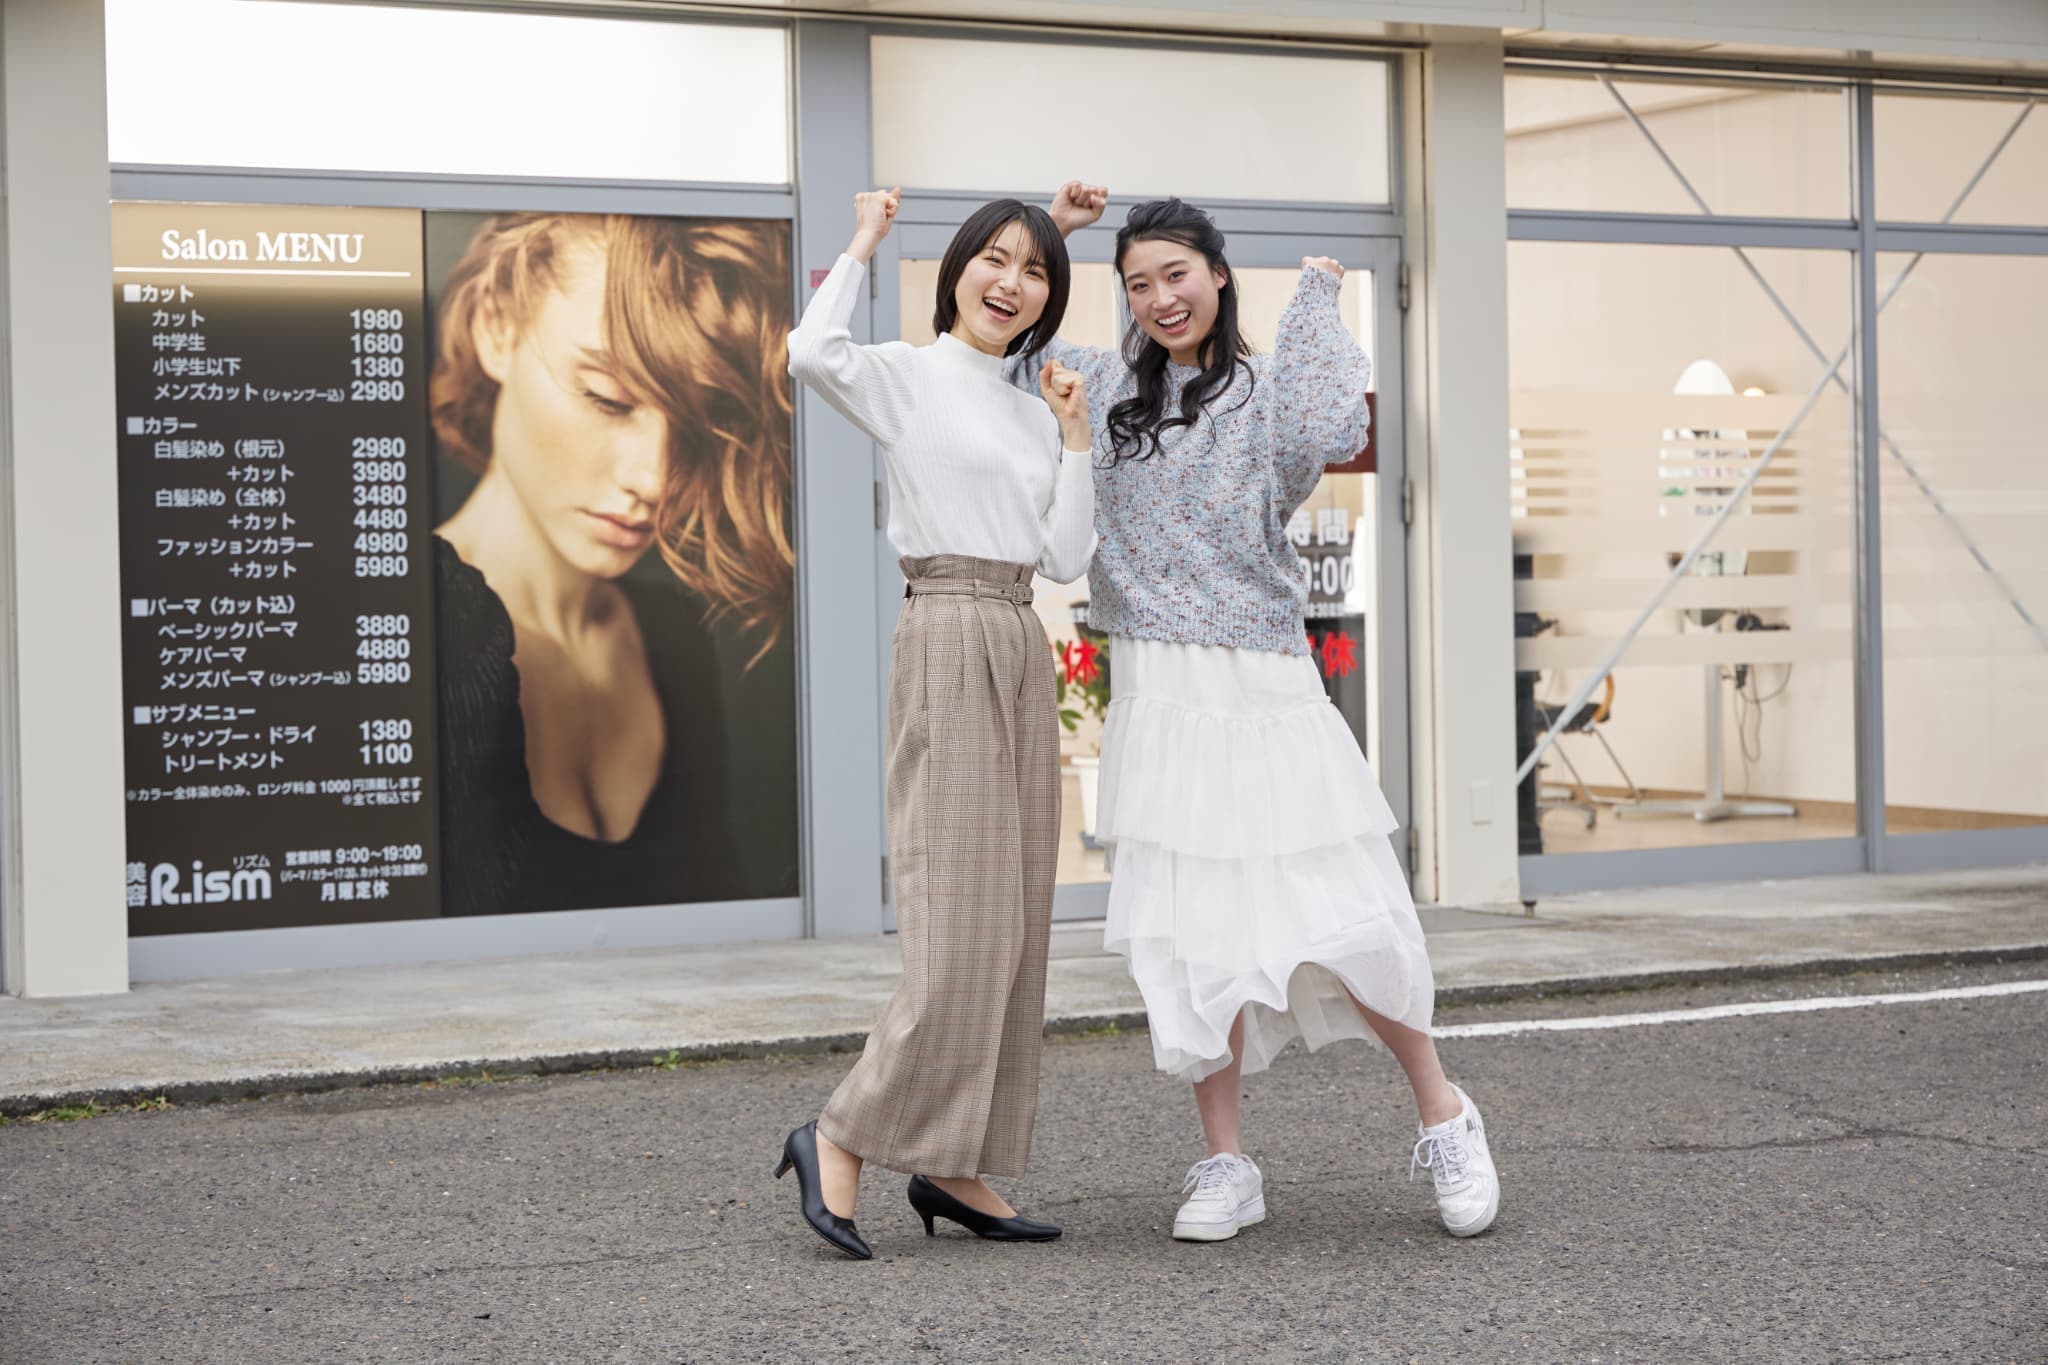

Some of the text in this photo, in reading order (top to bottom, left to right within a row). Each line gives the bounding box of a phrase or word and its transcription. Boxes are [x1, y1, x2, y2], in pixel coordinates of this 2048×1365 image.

[163, 230, 363, 262] Salon MENU
[141, 285, 195, 302] カット
[153, 309, 402, 329] カット 1980
[153, 333, 403, 353] 中学生 1680
[153, 357, 403, 377] 小学生以下 1380
[352, 381, 404, 401] 2980
[143, 417, 197, 434] カラー
[353, 438, 405, 458] 2980
[353, 462, 405, 482] 3980
[354, 485, 406, 505] 3480
[354, 509, 407, 529] 4480
[158, 533, 407, 555] ファッションカラー 4980
[356, 556, 408, 577] 5980
[159, 615, 409, 639] ベーシックパーマ 3880
[160, 639, 410, 665] ケアパーマ 4880
[358, 662, 410, 683] 5980
[150, 705, 255, 723] サブメニュー
[163, 719, 411, 748] シャンプー・ドライ 1380
[166, 744, 412, 772] トリートメント 1100
[233, 854, 271, 869] リズム
[150, 860, 272, 906] R.ism
[320, 879, 390, 902] 月曜定休
